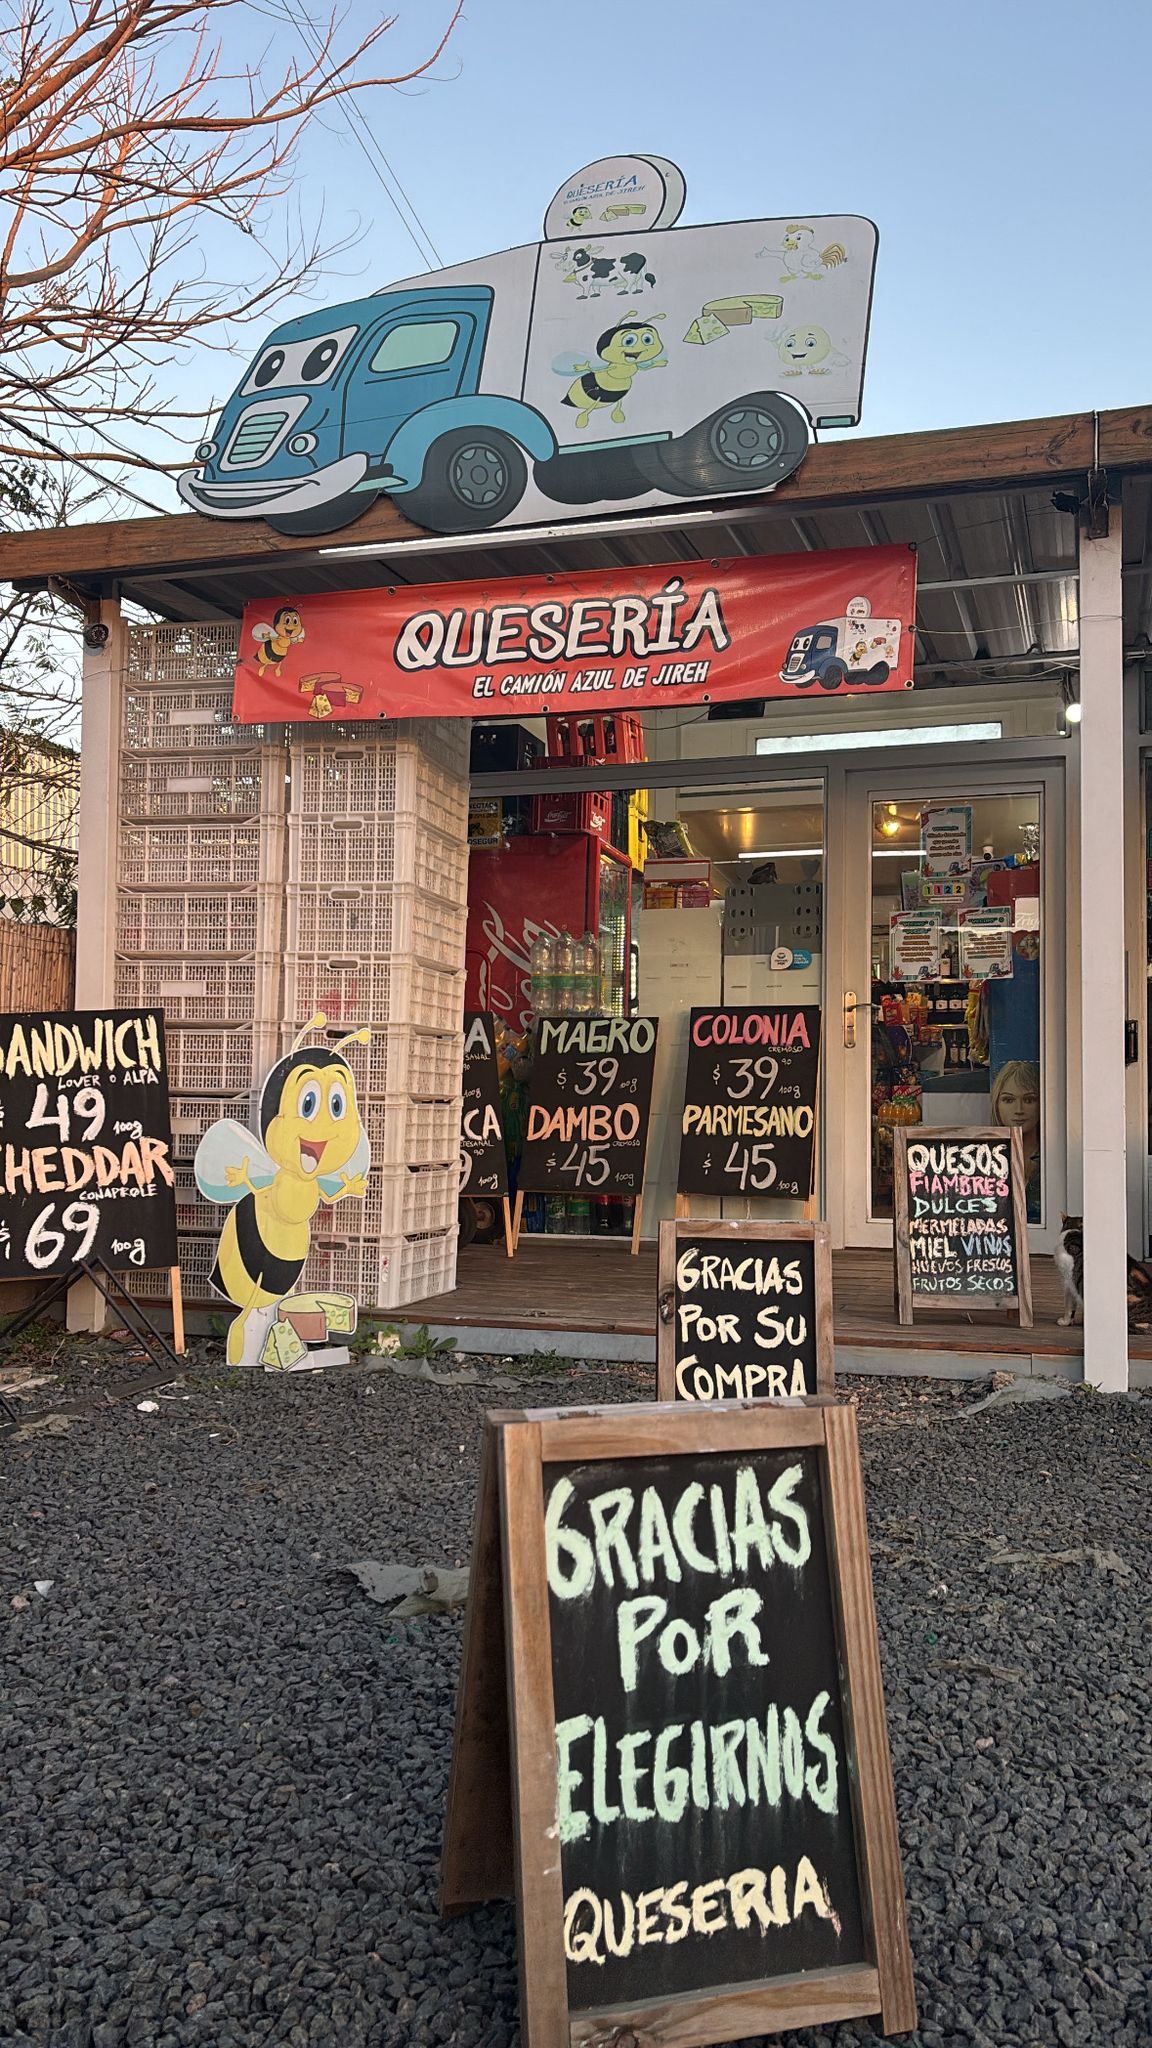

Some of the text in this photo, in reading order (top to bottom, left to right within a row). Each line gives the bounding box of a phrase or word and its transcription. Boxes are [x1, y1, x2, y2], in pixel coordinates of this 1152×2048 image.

[394, 576, 731, 671] QUESERÍA
[472, 661, 711, 698] EL CAMIÓN AZUL DE JIREH
[0, 1015, 162, 1080] ANDWICH
[540, 1018, 655, 1054] MAGRO
[692, 1012, 811, 1048] COLONIA
[58, 1075, 100, 1090] LOVER
[123, 1068, 159, 1085] ALPA
[557, 1057, 637, 1096] $ 39 00g
[713, 1063, 720, 1085] $
[727, 1056, 779, 1100] 39
[25, 1083, 106, 1143] 49
[113, 1121, 143, 1139] 100g
[460, 1104, 502, 1140] CA
[527, 1103, 641, 1142] DAMBO
[682, 1105, 814, 1138] PARMESANO
[546, 1143, 634, 1187] $ 45 100g
[702, 1152, 712, 1175] $
[724, 1141, 777, 1190] 45
[907, 1143, 1009, 1178] QUESOS
[79, 1184, 158, 1201] CONAPROLE
[478, 1173, 498, 1189] 100g
[909, 1172, 1009, 1197] FIAMBRES
[909, 1218, 1008, 1236] MERMELADAS
[912, 1197, 998, 1218] DULCES
[24, 1202, 100, 1269] 69
[111, 1238, 146, 1265] 100g
[910, 1235, 958, 1259] MIEL
[676, 1247, 803, 1296] GRACIAS
[912, 1258, 1013, 1274] HUEVOS FRESCOS
[912, 1275, 1014, 1291] FRUTOS SECOS
[678, 1303, 807, 1349] POR SU
[675, 1353, 808, 1401] COMPRA
[545, 1463, 812, 1600] GRACIAS
[617, 1586, 770, 1694] POR
[555, 1690, 840, 1845] ELEGIRNOS
[563, 1855, 842, 1966] QUESERIA
